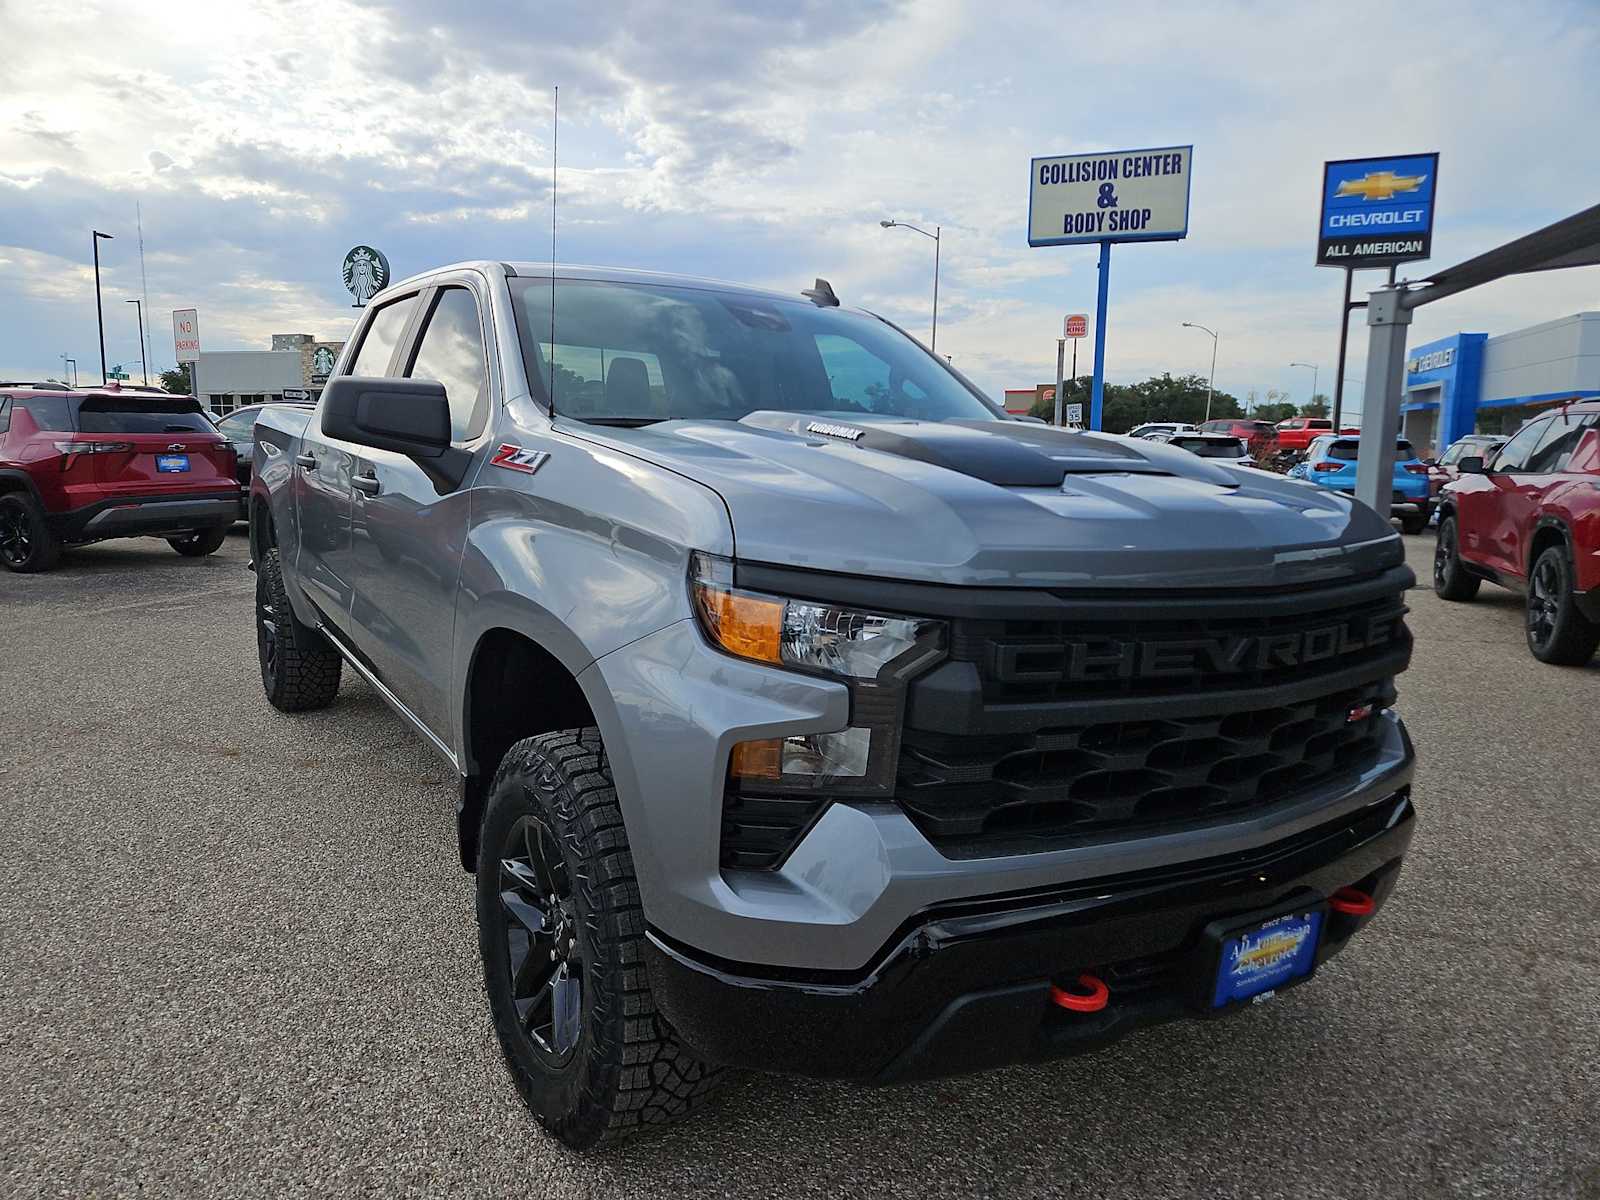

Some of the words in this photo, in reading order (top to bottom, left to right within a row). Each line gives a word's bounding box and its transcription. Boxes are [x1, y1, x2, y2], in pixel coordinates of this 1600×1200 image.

[1040, 159, 1118, 185] COLLISION
[1123, 153, 1182, 178] CENTER
[1097, 182, 1118, 208] &
[1064, 211, 1105, 234] BODY
[1109, 209, 1151, 231] SHOP
[1329, 210, 1424, 228] CHEVROLET
[1326, 245, 1350, 257] ALL
[1353, 240, 1423, 256] AMERICAN
[179, 320, 192, 333] NO
[176, 340, 199, 350] PARKING
[1418, 348, 1456, 371] CHEVROLET
[806, 421, 865, 441] TURBOMAX
[490, 442, 551, 475] Z71
[986, 619, 1393, 683] CHEVROLE
